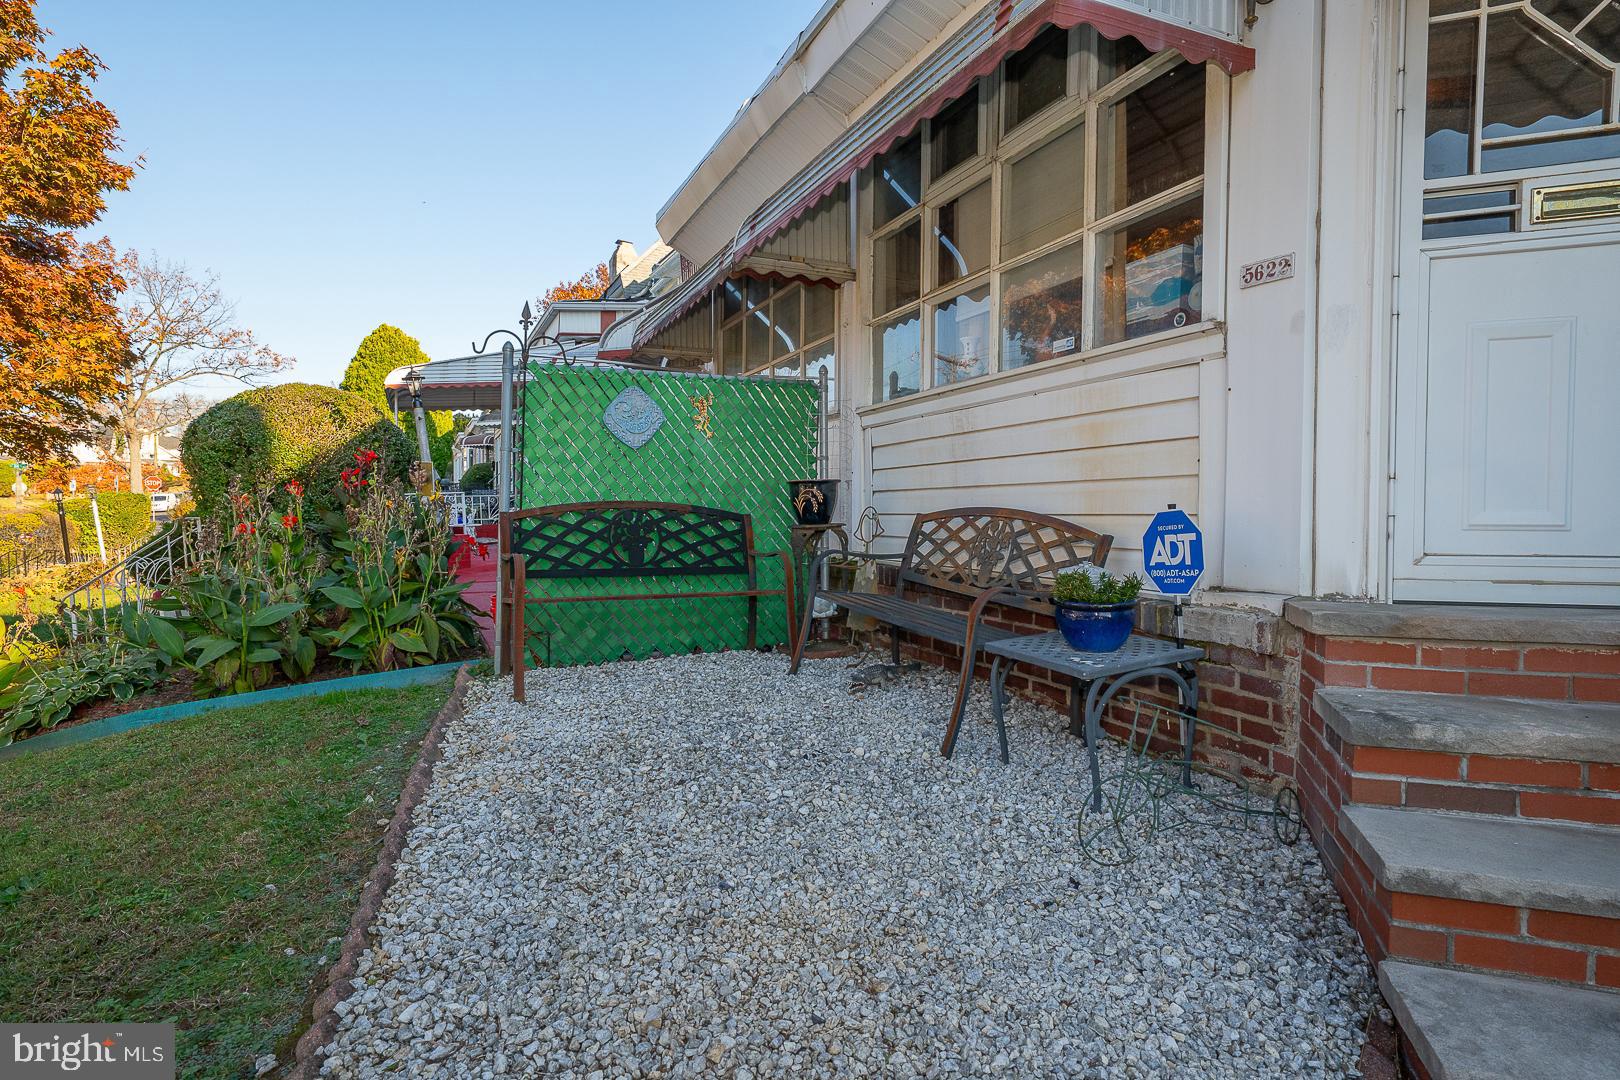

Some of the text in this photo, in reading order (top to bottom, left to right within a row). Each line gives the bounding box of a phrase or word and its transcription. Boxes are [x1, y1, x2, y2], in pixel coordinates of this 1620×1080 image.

[1244, 258, 1290, 283] 5622
[1150, 533, 1196, 566] ADT
[1166, 569, 1199, 577] ADT-ASAP
